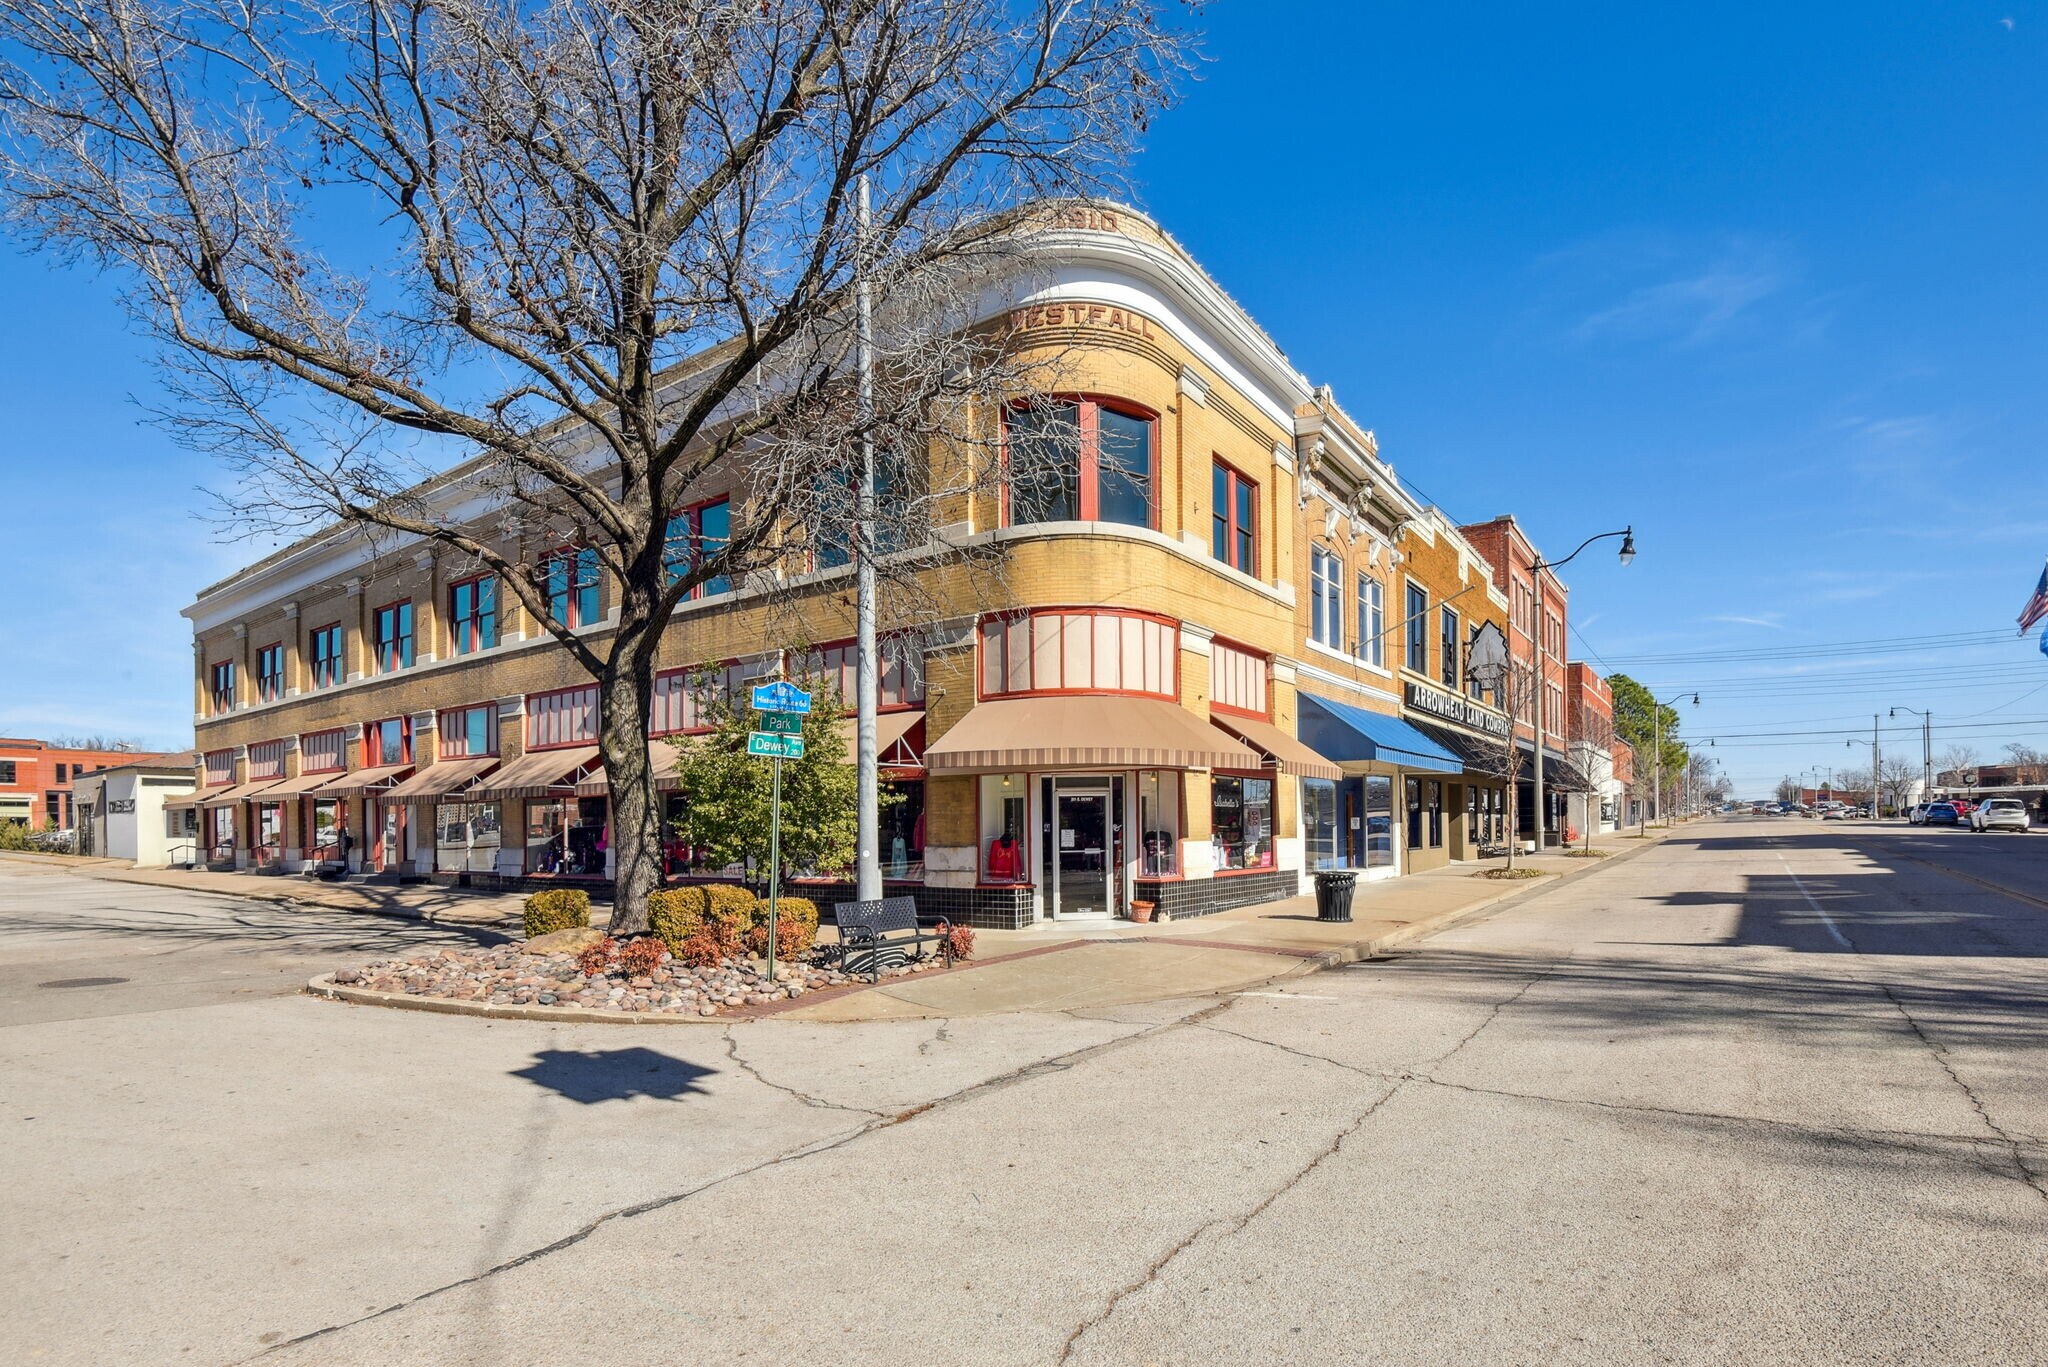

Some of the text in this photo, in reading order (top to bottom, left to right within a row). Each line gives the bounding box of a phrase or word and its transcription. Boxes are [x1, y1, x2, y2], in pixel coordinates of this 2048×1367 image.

[1010, 303, 1155, 342] WESTFALL
[1413, 685, 1465, 721] ARROWHEAD
[1467, 706, 1484, 728] LAND
[770, 717, 791, 730] Park
[755, 738, 790, 756] Dewey
[723, 866, 743, 876] SALE
